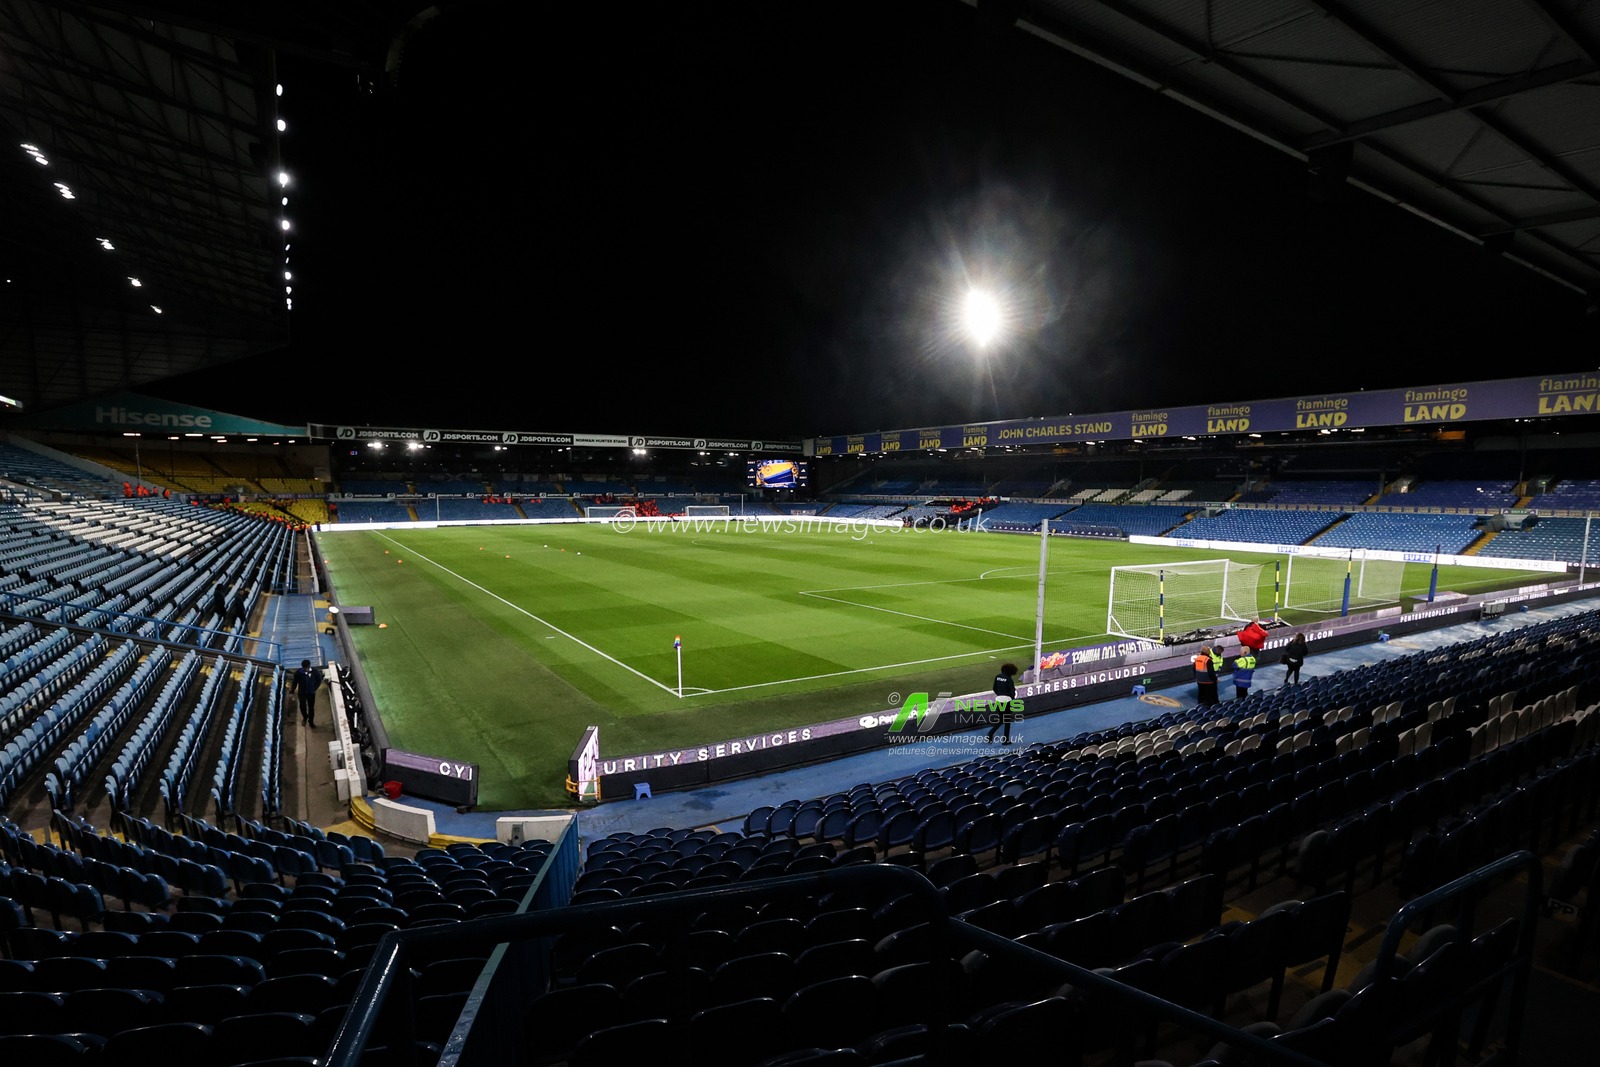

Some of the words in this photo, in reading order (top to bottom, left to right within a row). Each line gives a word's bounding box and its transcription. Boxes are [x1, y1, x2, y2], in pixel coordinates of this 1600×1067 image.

[1405, 387, 1468, 402] flamingo
[1296, 397, 1348, 410] flamingo
[95, 406, 212, 428] Hisense
[1131, 411, 1168, 423] flamingo
[1207, 404, 1251, 417] flamingo
[1404, 403, 1466, 422] LAND
[1207, 417, 1250, 433] LAND
[1296, 412, 1348, 429] LAND
[357, 431, 419, 439] JDSPORTS.COM
[998, 429, 1024, 439] JOHN
[1025, 425, 1072, 438] CHARLES
[1074, 421, 1113, 435] STAND
[1131, 423, 1168, 437] LAND
[442, 433, 498, 441] JDSPORTS.COM
[520, 436, 572, 444] JDSPORTS.COM
[963, 435, 987, 447] LAND
[847, 444, 865, 453] LAND
[881, 441, 901, 451] LAND
[919, 439, 941, 449] LAND
[1404, 554, 1431, 562] SUPER
[1476, 558, 1500, 566] PLAY
[1504, 560, 1525, 568] FOR
[1527, 561, 1553, 570] FREE
[1400, 607, 1458, 623] PENTESTPEOPLE.COM
[1027, 678, 1077, 696] STRESS
[1085, 666, 1146, 686] INCLUDED
[603, 752, 682, 775] URITY
[697, 728, 812, 761] SERVICES
